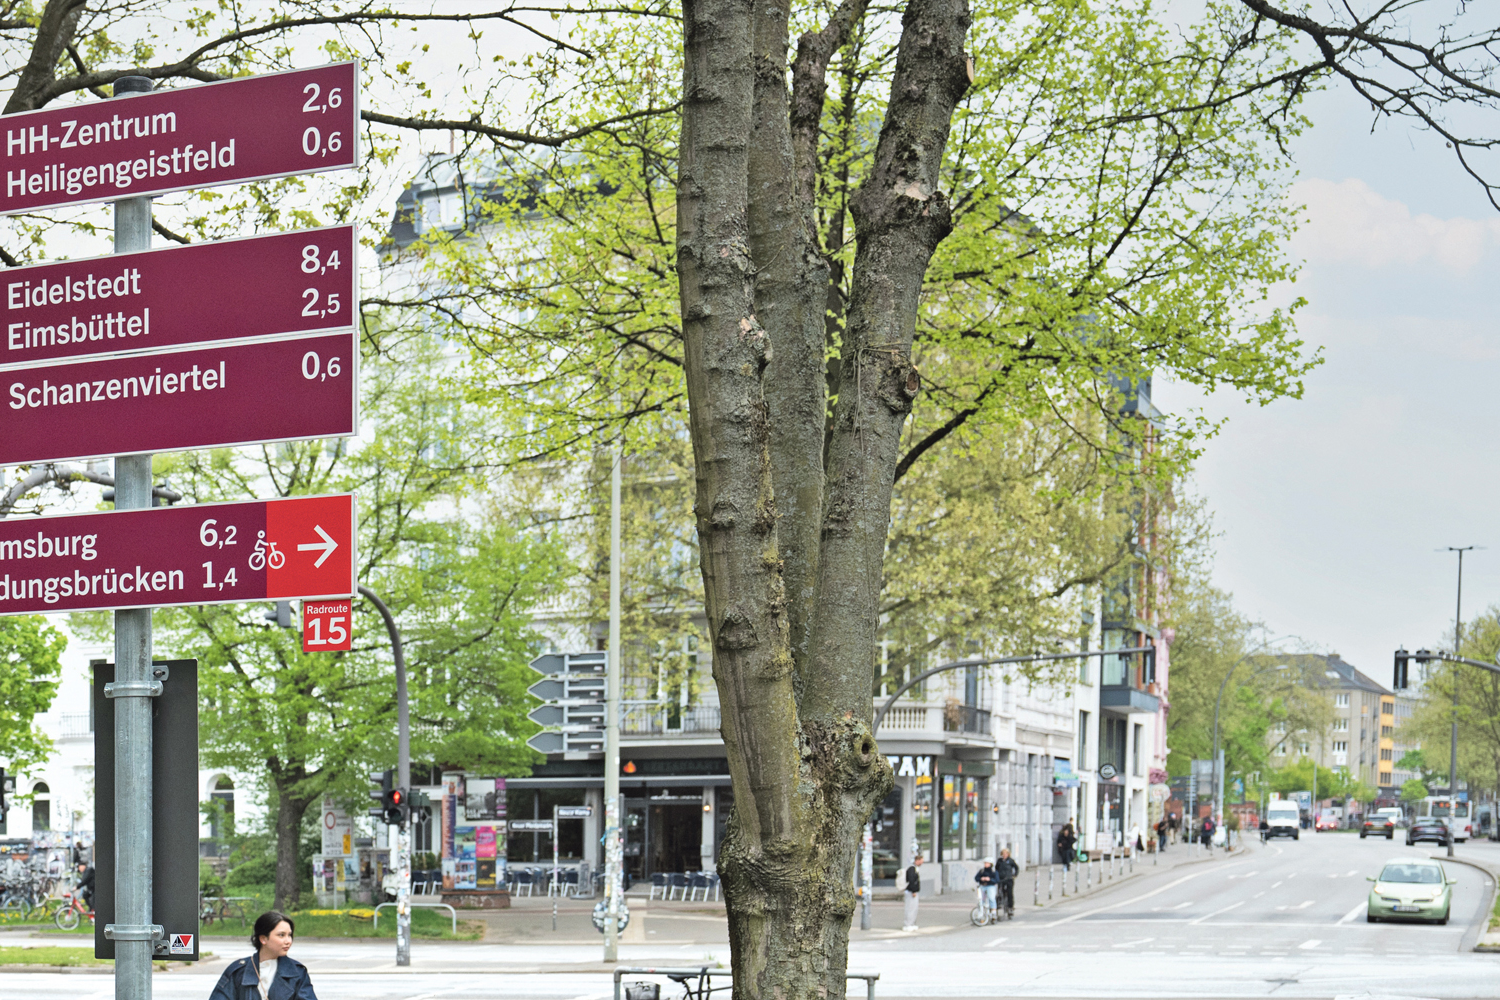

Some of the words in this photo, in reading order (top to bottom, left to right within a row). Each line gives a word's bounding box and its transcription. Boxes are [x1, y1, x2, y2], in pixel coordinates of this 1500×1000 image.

[8, 112, 176, 156] HH-Zentrum
[303, 83, 341, 113] 2,6
[8, 139, 235, 197] Heiligengeistfeld
[303, 127, 341, 157] 0,6
[8, 269, 141, 309] Eidelstedt
[301, 245, 340, 275] 8,4
[9, 308, 149, 350] Eimsbüttel
[302, 288, 340, 318] 2,5
[9, 361, 225, 409] Schanzenviertel
[302, 351, 340, 382] 0,6
[200, 519, 237, 549] 6,2
[202, 561, 237, 591] 1,4
[307, 604, 347, 614] Radroute
[308, 617, 346, 645] 15
